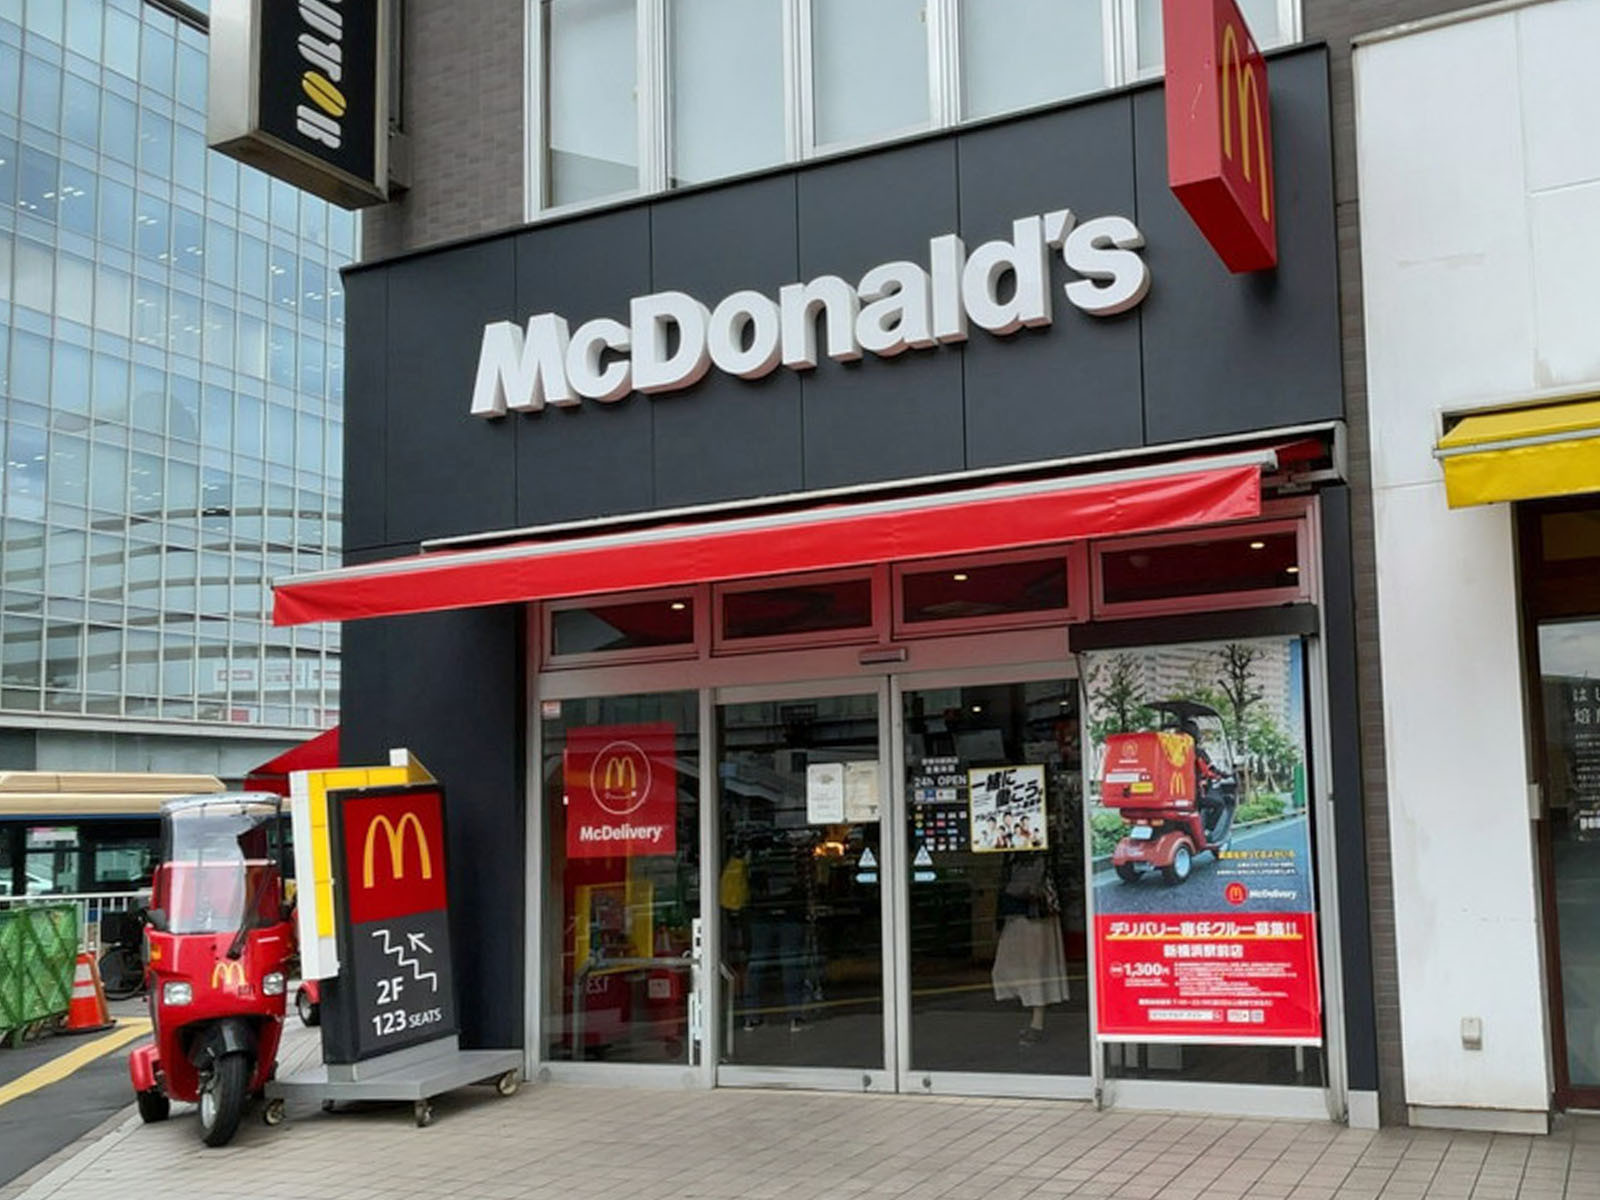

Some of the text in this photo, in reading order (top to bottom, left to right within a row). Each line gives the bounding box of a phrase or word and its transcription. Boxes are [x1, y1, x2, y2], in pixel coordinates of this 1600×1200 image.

[297, 0, 347, 149] UTOR
[470, 207, 1151, 419] McDonald's
[579, 824, 663, 843] McDelivery
[1249, 889, 1297, 900] McDelivery
[376, 976, 405, 1005] 2F
[372, 1007, 443, 1037] 123 SEATS
